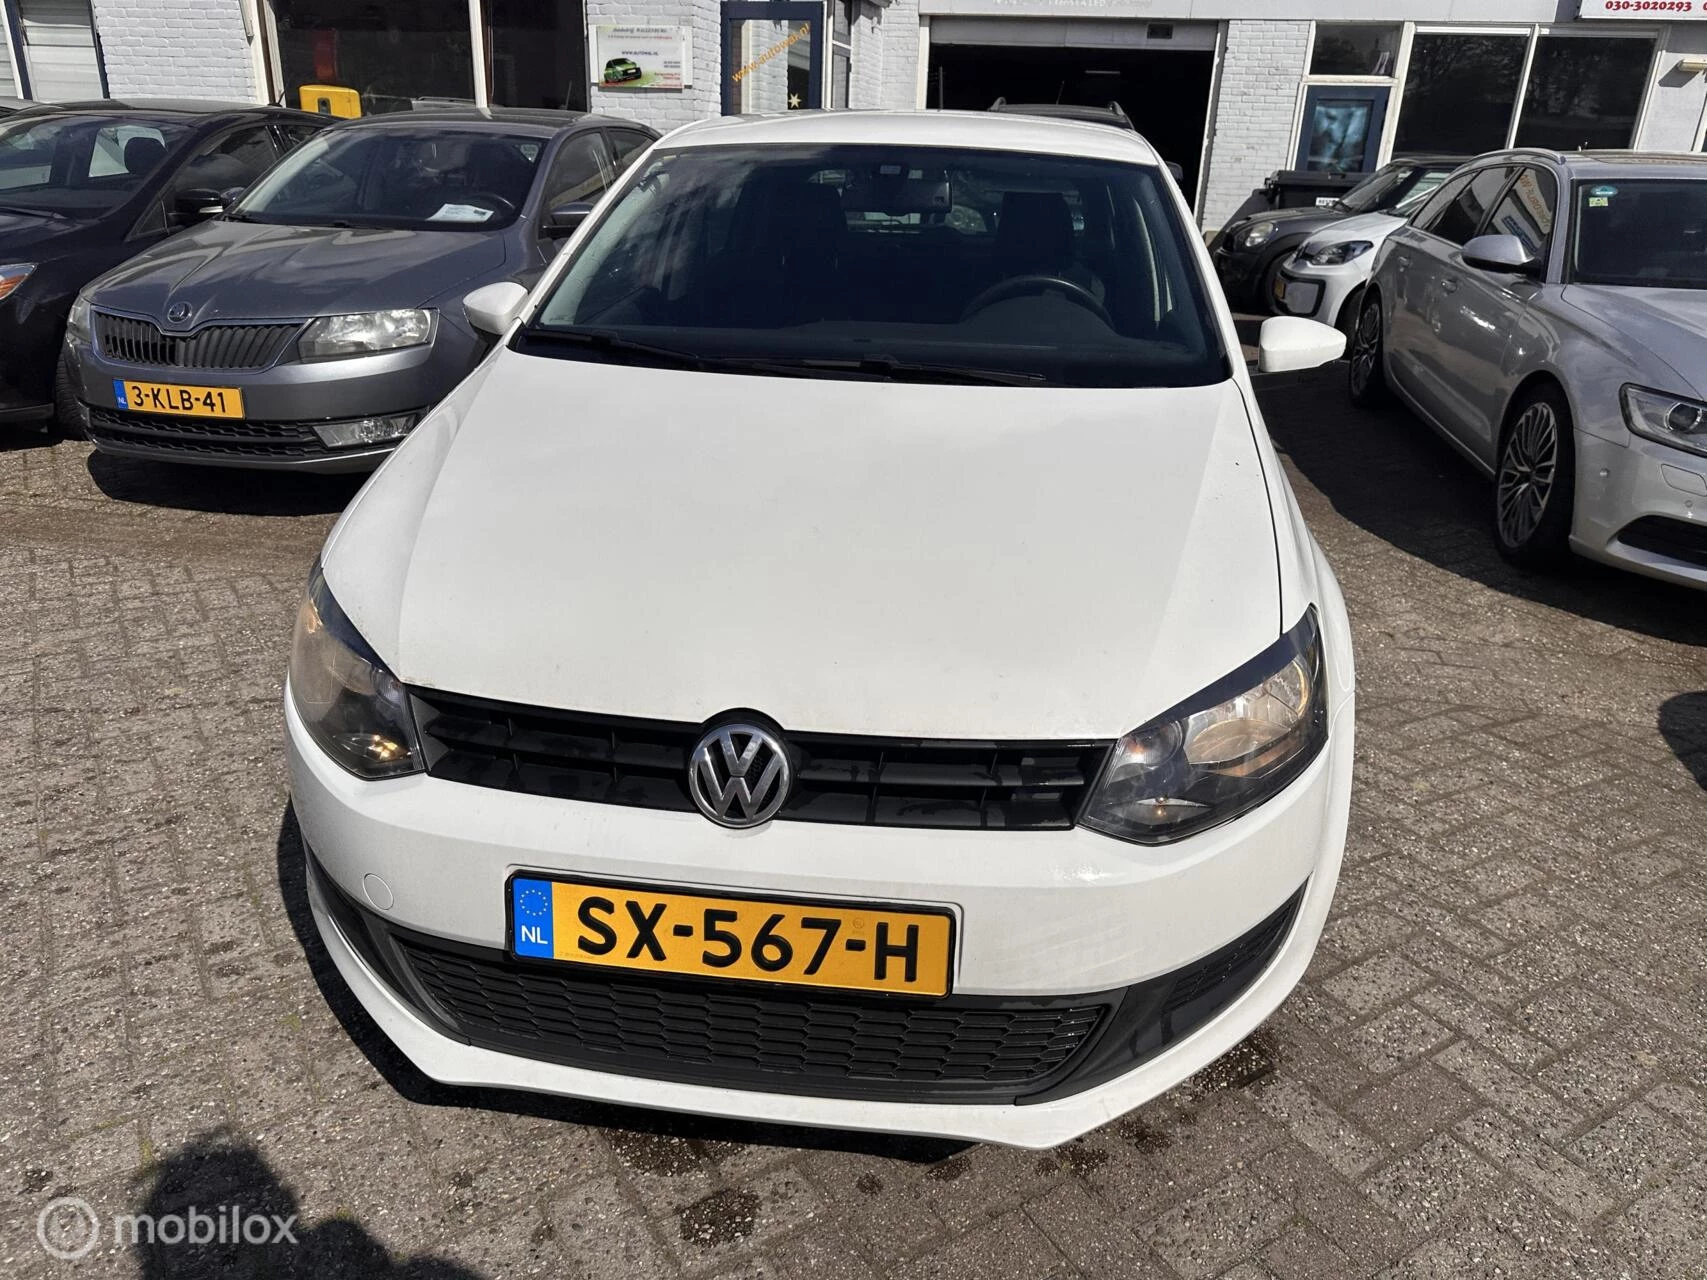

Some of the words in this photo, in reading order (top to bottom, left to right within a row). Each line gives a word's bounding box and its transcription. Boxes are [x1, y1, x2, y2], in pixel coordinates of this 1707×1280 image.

[1605, 0, 1692, 12] 030-3020293
[131, 385, 226, 413] 3-KLB-41
[521, 925, 548, 945] NL
[577, 896, 919, 983] SX-567-H
